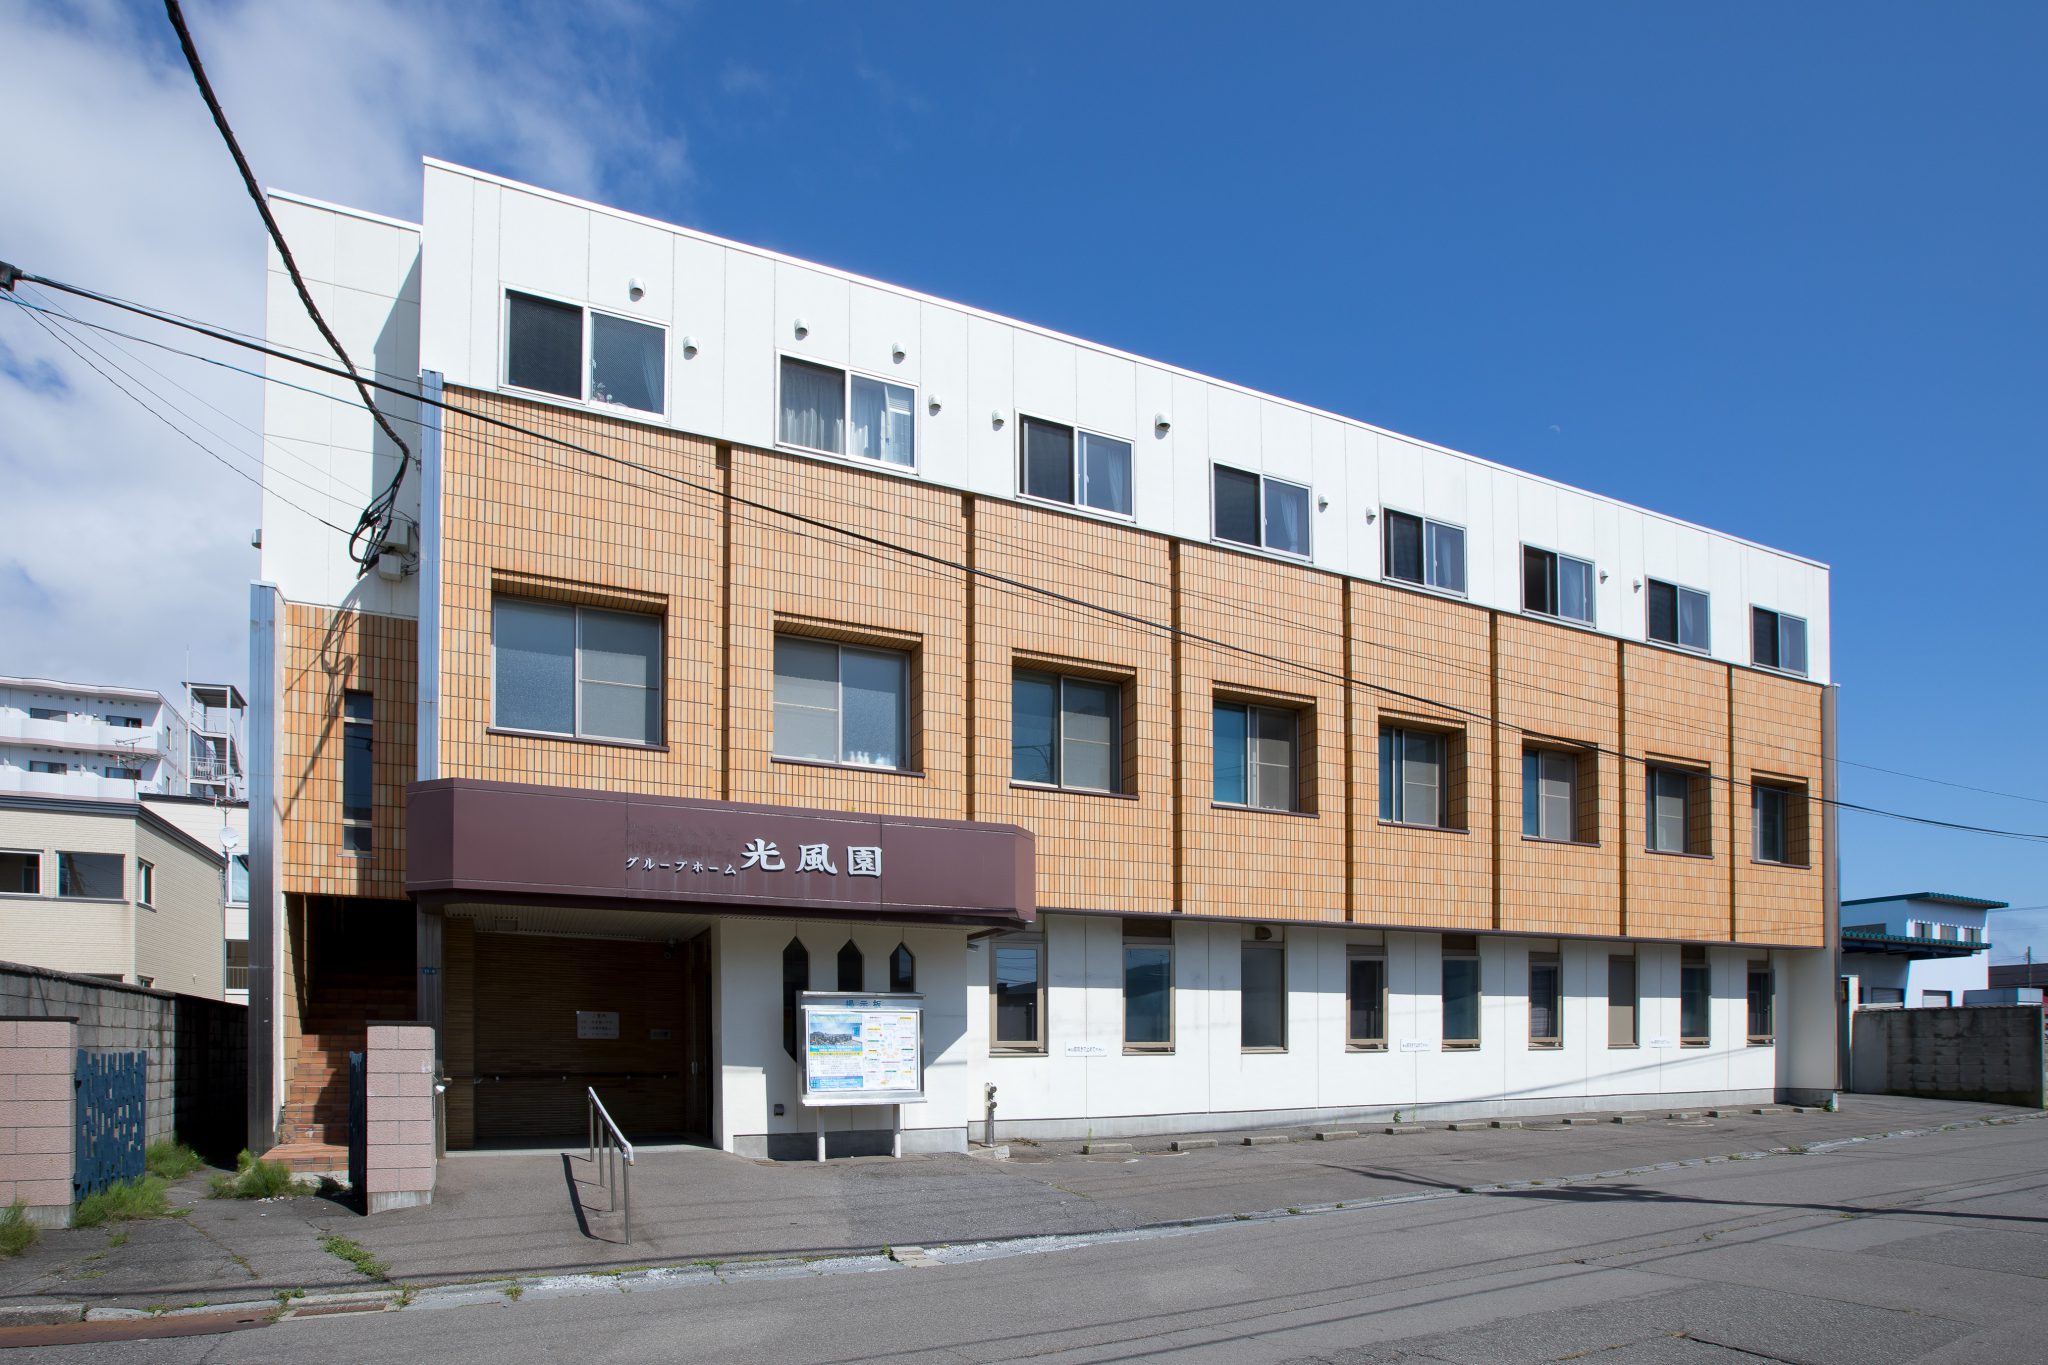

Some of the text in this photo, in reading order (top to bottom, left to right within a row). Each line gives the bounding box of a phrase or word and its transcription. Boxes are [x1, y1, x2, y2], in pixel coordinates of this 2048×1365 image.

[625, 856, 737, 876] グループホーム
[740, 838, 882, 877] 光風園
